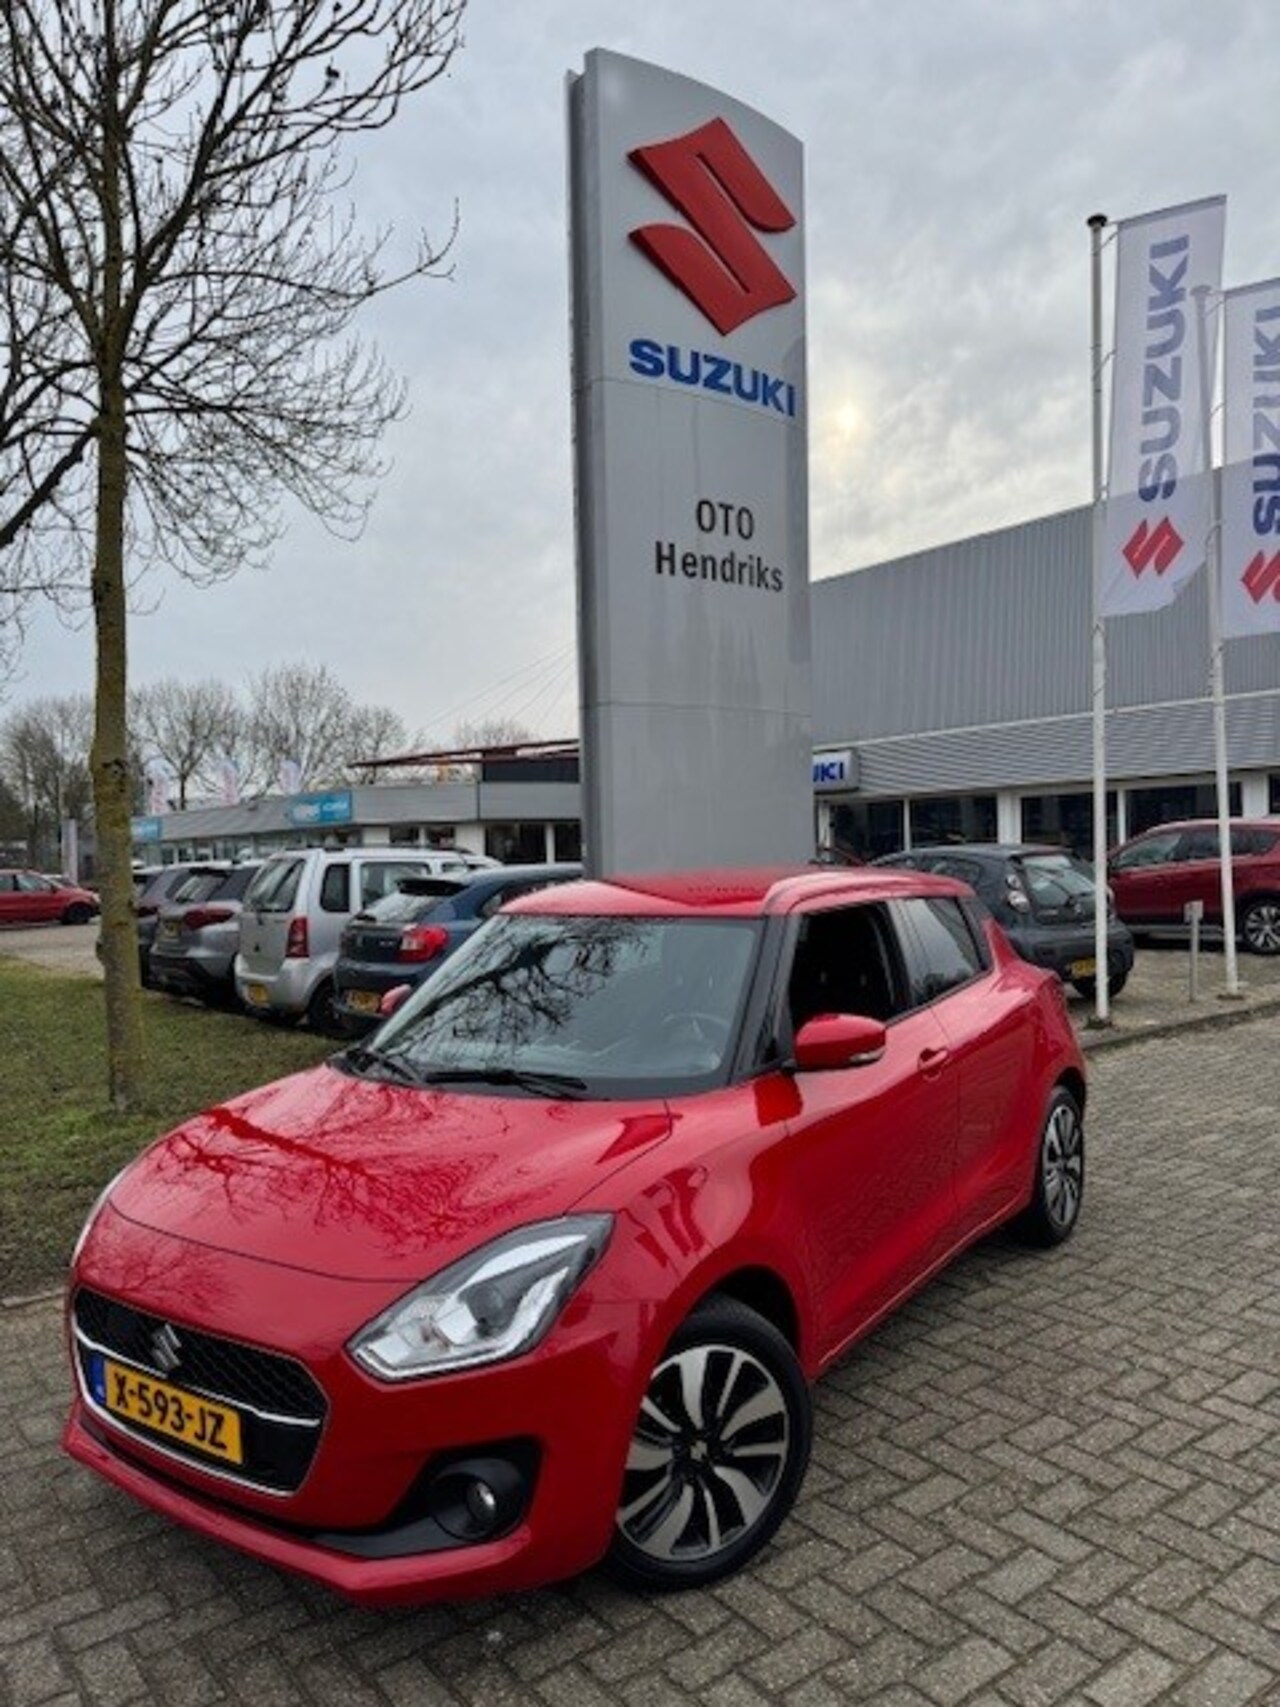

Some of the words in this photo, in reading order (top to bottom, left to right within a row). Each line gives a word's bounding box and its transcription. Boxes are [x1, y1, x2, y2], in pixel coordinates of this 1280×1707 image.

[628, 338, 796, 418] SUZUKI
[1138, 235, 1190, 502] SUZUKI
[695, 499, 755, 540] OTO
[655, 541, 783, 593] Hendriks
[113, 1372, 227, 1450] X-593-JZ
